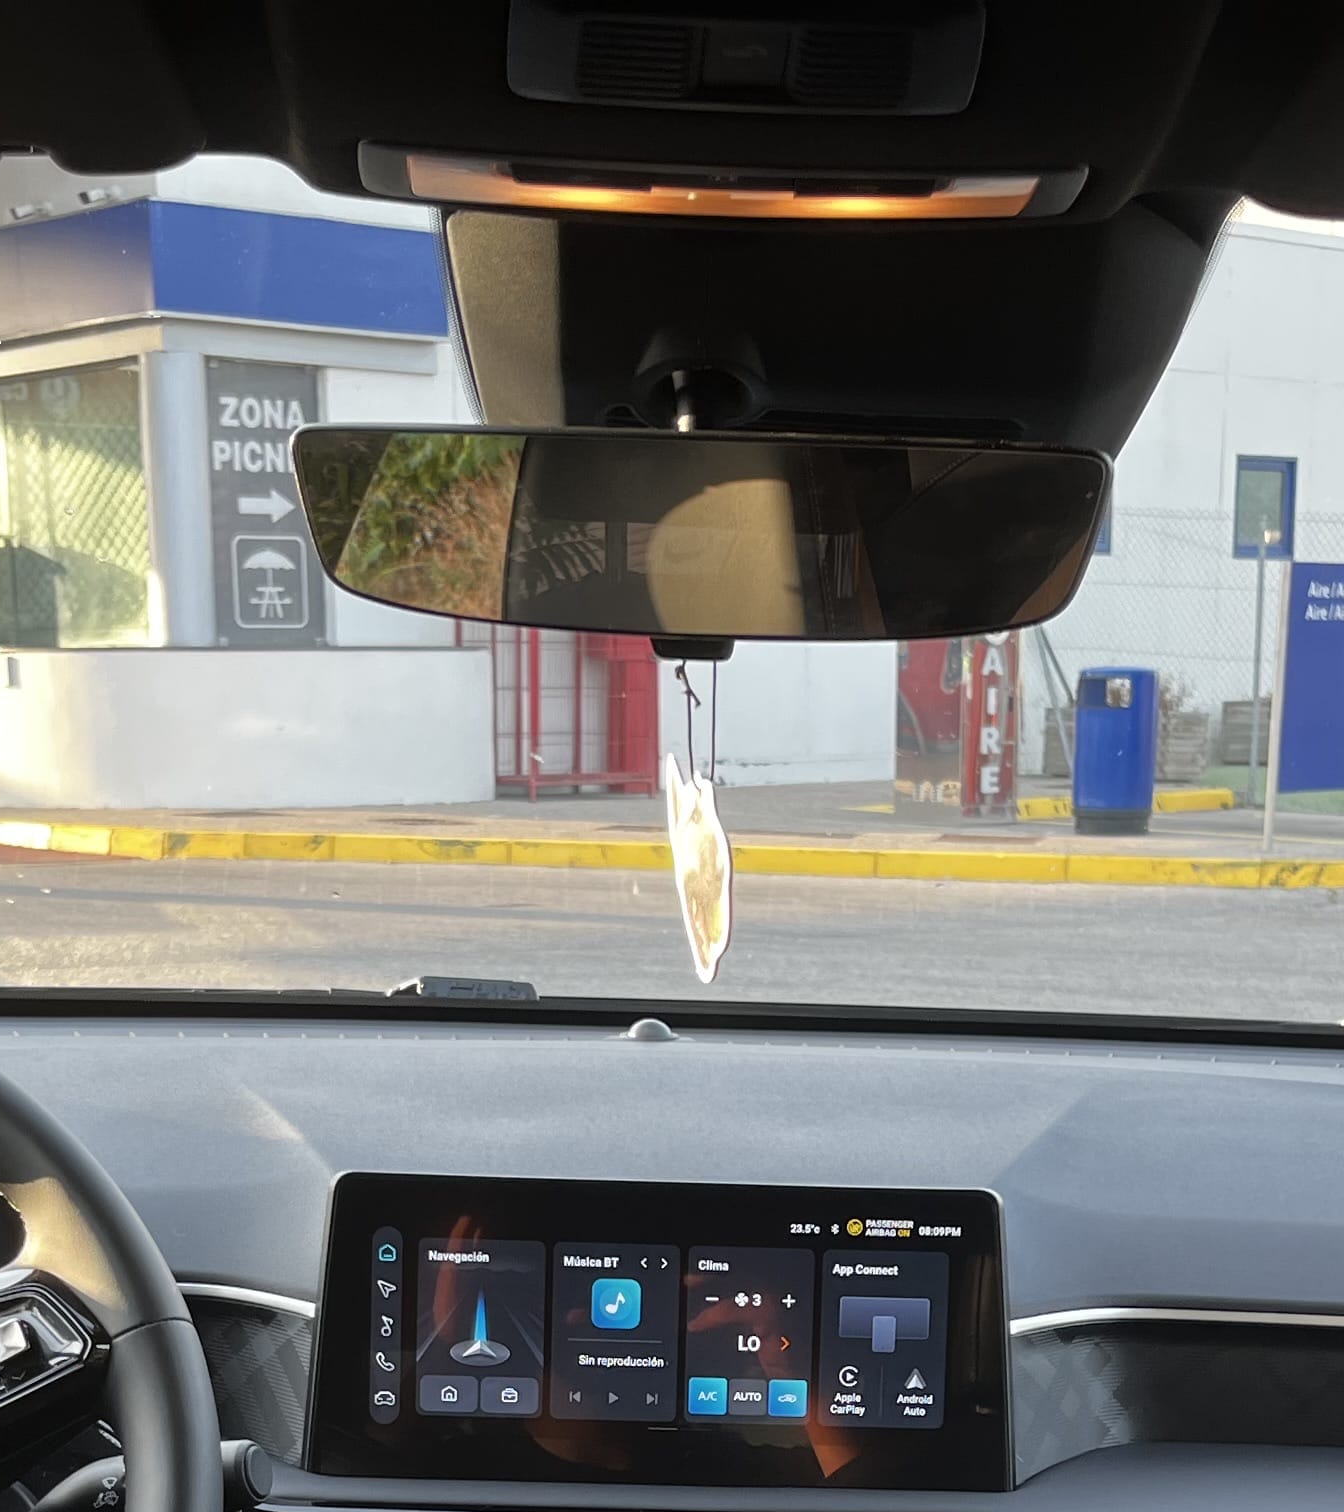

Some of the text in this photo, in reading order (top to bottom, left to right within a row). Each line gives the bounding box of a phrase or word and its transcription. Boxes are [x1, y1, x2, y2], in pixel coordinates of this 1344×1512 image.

[218, 396, 305, 430] ZONA
[212, 440, 296, 474] PICNI
[1307, 580, 1330, 599] Aire
[1304, 603, 1327, 621] Aire
[980, 648, 1004, 794] AIRE
[865, 1219, 914, 1229] PASSENGER
[864, 1228, 911, 1238] AIRBAG ON
[428, 1250, 490, 1264] Navegación
[563, 1255, 619, 1268] Música BT
[698, 1259, 730, 1272] Clima
[832, 1263, 899, 1277] App Connect
[752, 1294, 762, 1307] 3
[737, 1334, 761, 1352] LO
[578, 1354, 665, 1369] Sin reproducción
[697, 1391, 718, 1402] A/C
[733, 1391, 762, 1403] AUTO
[833, 1392, 862, 1404] Apple
[896, 1393, 934, 1406] Android
[829, 1403, 866, 1418] CarPlay
[903, 1405, 926, 1418] Auto
